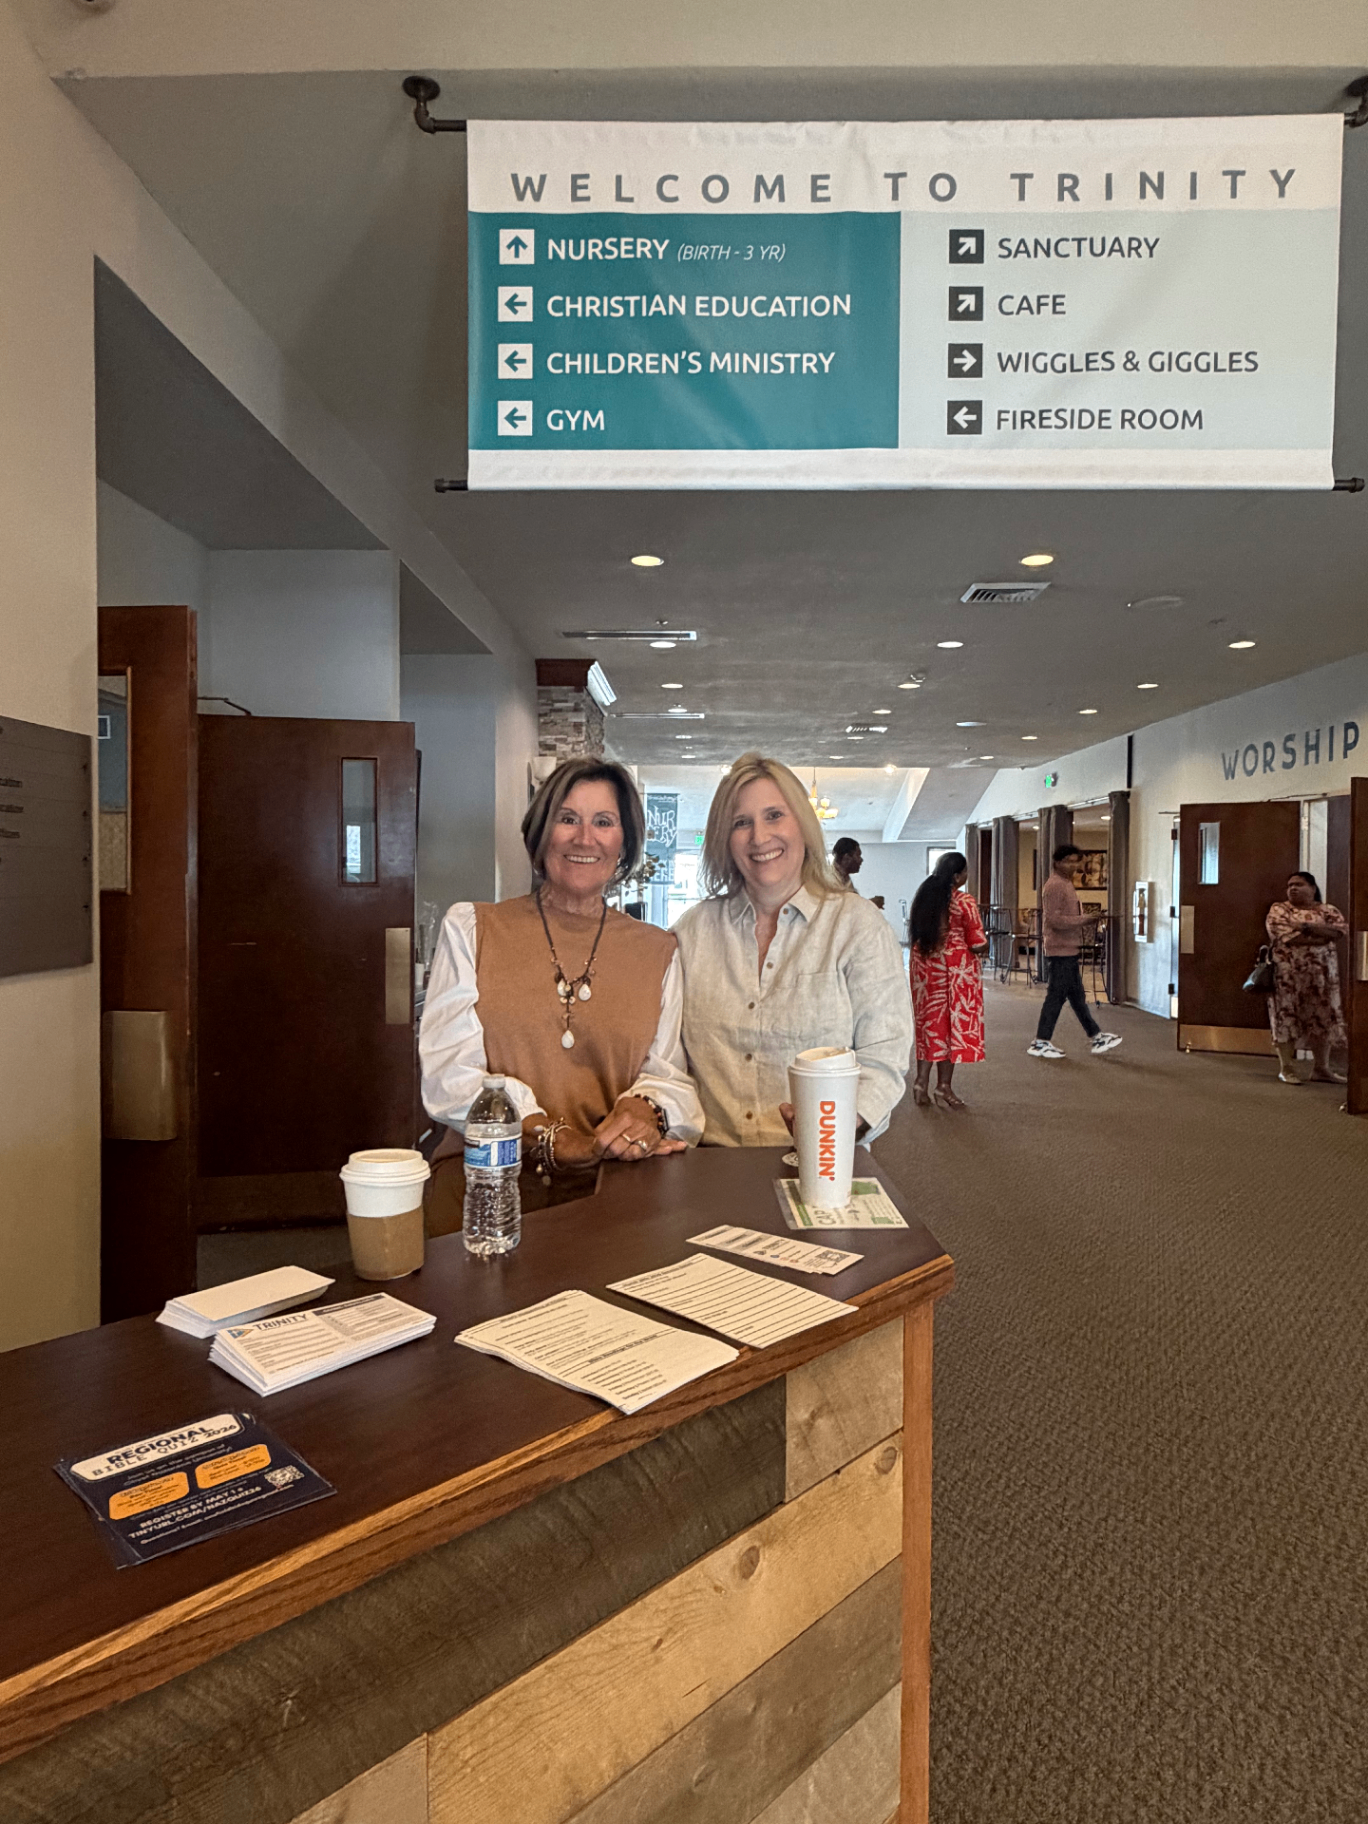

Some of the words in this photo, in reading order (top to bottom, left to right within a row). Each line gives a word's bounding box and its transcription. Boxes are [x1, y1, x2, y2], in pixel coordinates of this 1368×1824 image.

[510, 172, 832, 203] WELCOME
[883, 171, 958, 203] TO
[1010, 168, 1297, 202] TRINITY
[547, 238, 670, 261] NURSERY
[677, 243, 732, 263] (BIRTH
[743, 244, 753, 261] 3
[758, 243, 786, 263] YR)
[997, 236, 1160, 259] SANCTUARY
[547, 294, 687, 317] CHRISTIAN
[696, 293, 851, 317] EDUCATION
[997, 294, 1067, 316] CAFE
[547, 351, 702, 375] CHILDREN'S
[710, 351, 835, 375] MINISTRY
[997, 350, 1115, 374] WIGGLES
[1123, 350, 1140, 373] &
[1148, 350, 1259, 373] GIGGLES
[546, 409, 605, 431] GYM
[996, 408, 1112, 431] FIRESIDE
[1120, 408, 1204, 431] ROOM
[1222, 721, 1360, 781] WORSHIP
[818, 1100, 836, 1182] DUNKIN'
[253, 1313, 308, 1332] TRINITY
[92, 1454, 147, 1476] BIBLE
[156, 1436, 199, 1454] QUIZ
[203, 1424, 237, 1438] 2026
[106, 1426, 213, 1464] REGIONAL
[140, 1506, 189, 1529] REGISTER
[190, 1502, 203, 1513] BY
[205, 1491, 230, 1504] MAY
